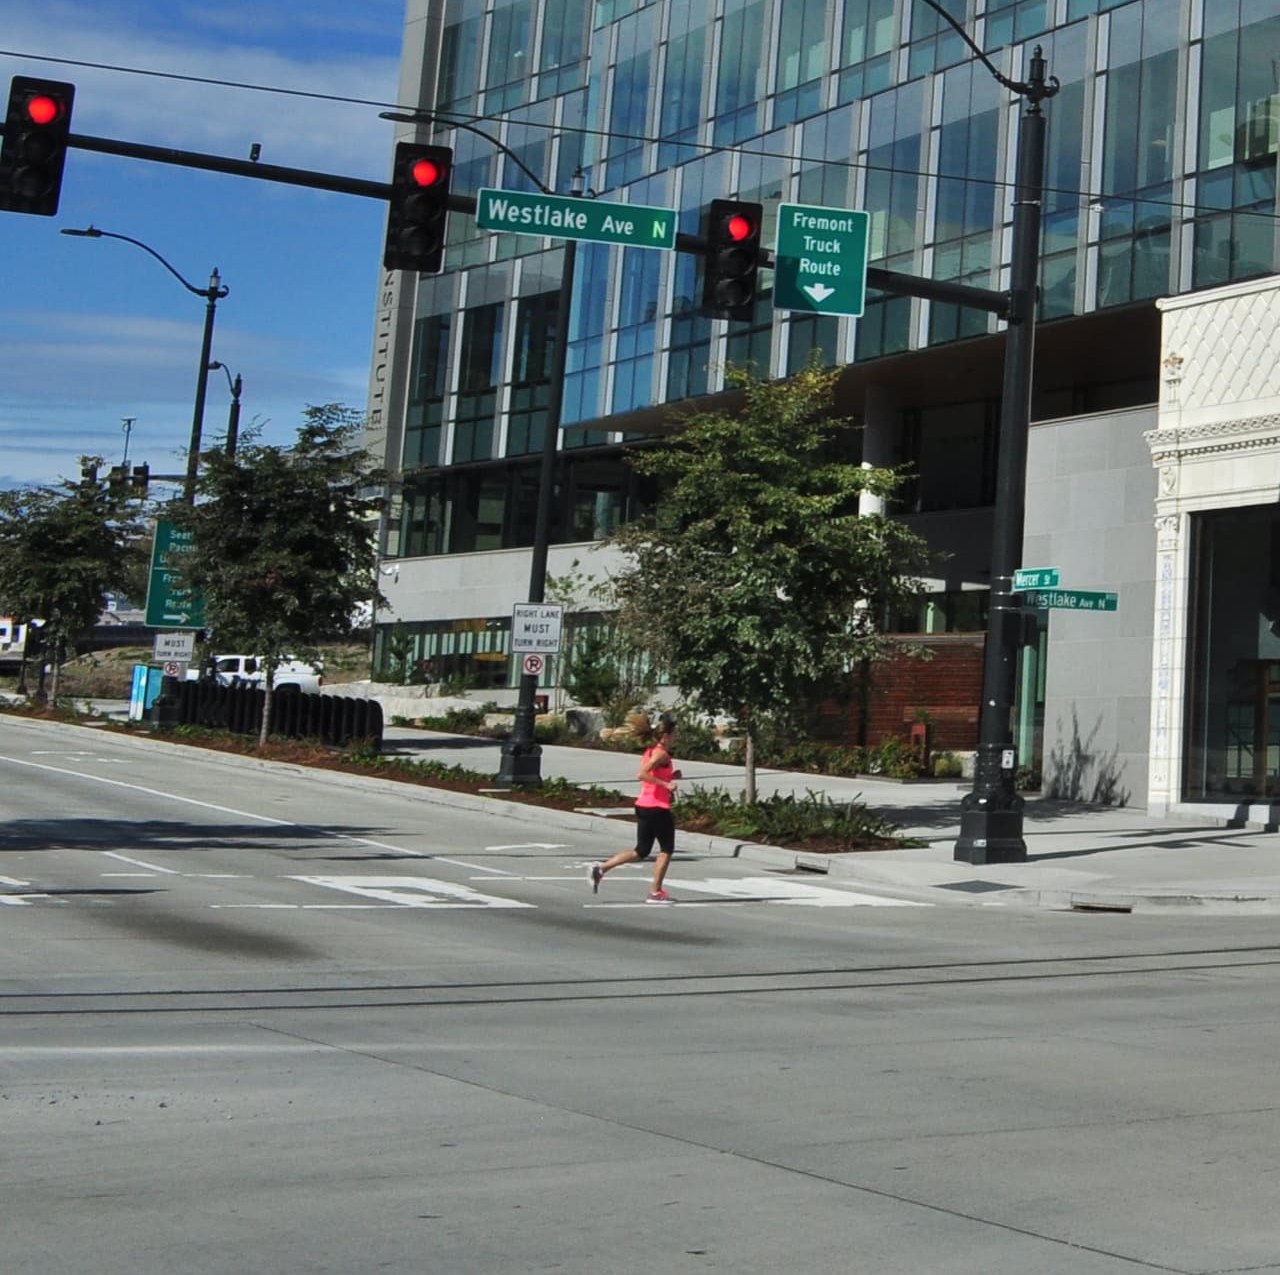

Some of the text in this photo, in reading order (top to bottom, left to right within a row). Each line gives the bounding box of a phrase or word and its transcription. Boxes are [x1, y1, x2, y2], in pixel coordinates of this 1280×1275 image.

[488, 198, 666, 239] Westlake Ave N
[793, 212, 853, 233] Fremont
[803, 235, 841, 254] Truck
[799, 258, 841, 276] Route
[1016, 572, 1040, 587] Mercer
[1026, 591, 1106, 609] Westlake Ave N
[516, 609, 560, 619] RIGHT LANE
[523, 623, 550, 634] MUST
[164, 638, 185, 648] MUST
[514, 638, 558, 648] TURN RIGHT
